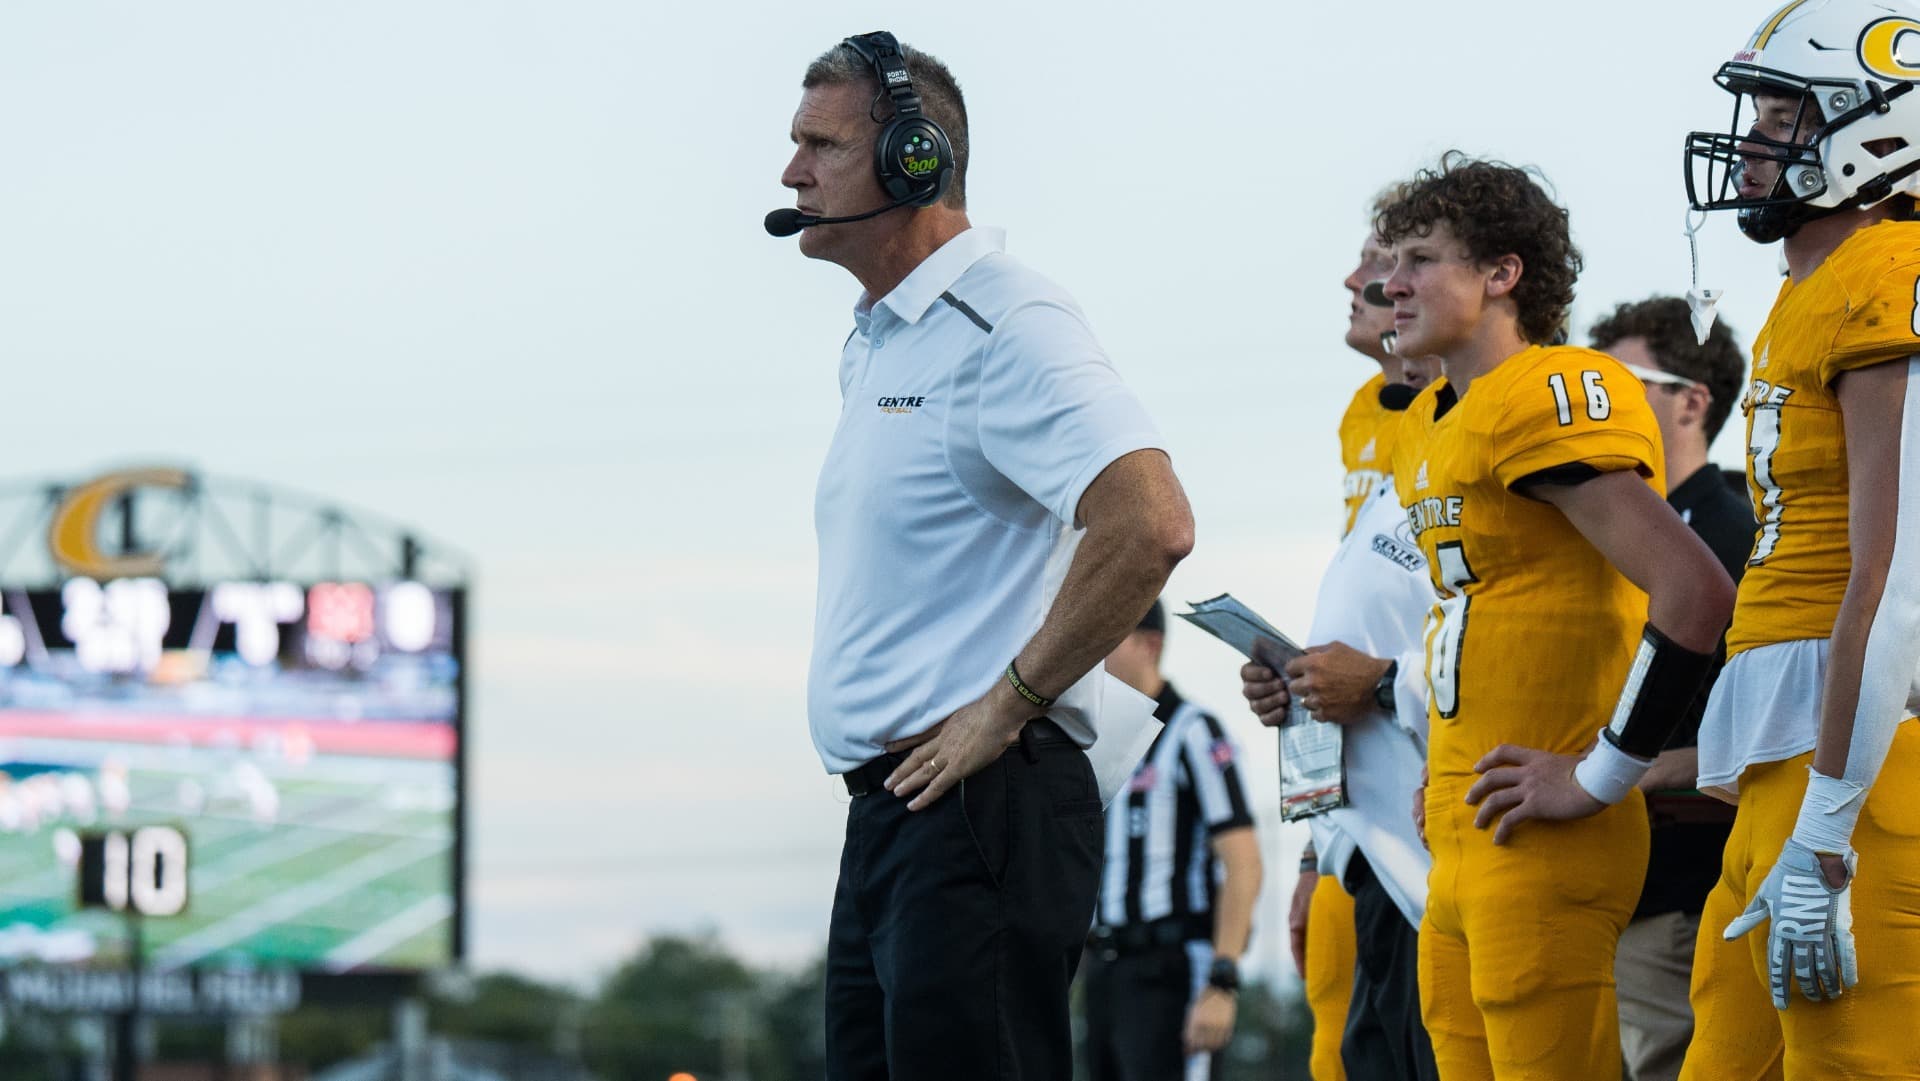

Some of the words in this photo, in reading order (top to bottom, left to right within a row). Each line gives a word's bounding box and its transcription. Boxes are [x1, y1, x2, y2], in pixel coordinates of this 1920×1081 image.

[1856, 16, 1920, 84] C
[886, 70, 907, 78] PORTA
[889, 76, 909, 84] PHONE
[908, 156, 938, 172] 900
[877, 396, 926, 407] CENTRE
[1548, 370, 1611, 427] 16
[1407, 496, 1463, 536] ENTRE
[103, 825, 188, 915] 10
